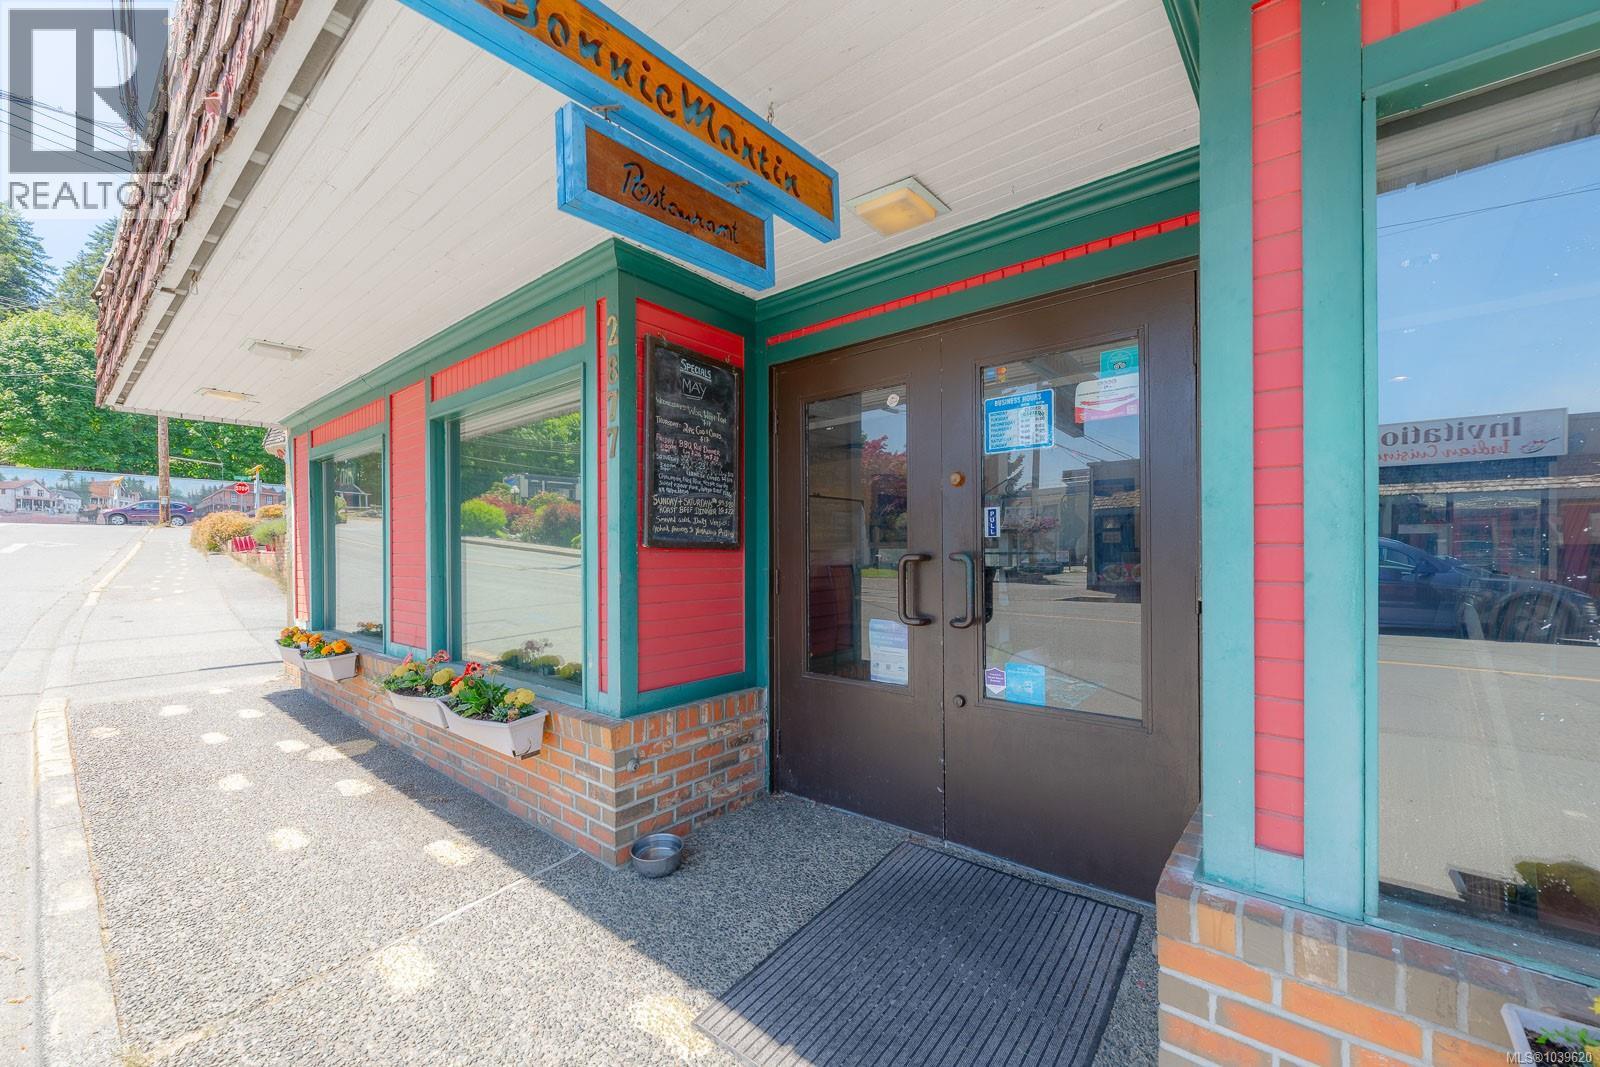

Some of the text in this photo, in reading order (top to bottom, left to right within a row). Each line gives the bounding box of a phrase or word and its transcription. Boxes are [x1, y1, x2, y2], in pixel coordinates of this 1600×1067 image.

[682, 82, 800, 198] Martin
[680, 359, 712, 379] SPECIALS
[607, 315, 618, 459] 2877
[682, 378, 707, 399] MAY
[994, 396, 1021, 407] BUSINESS
